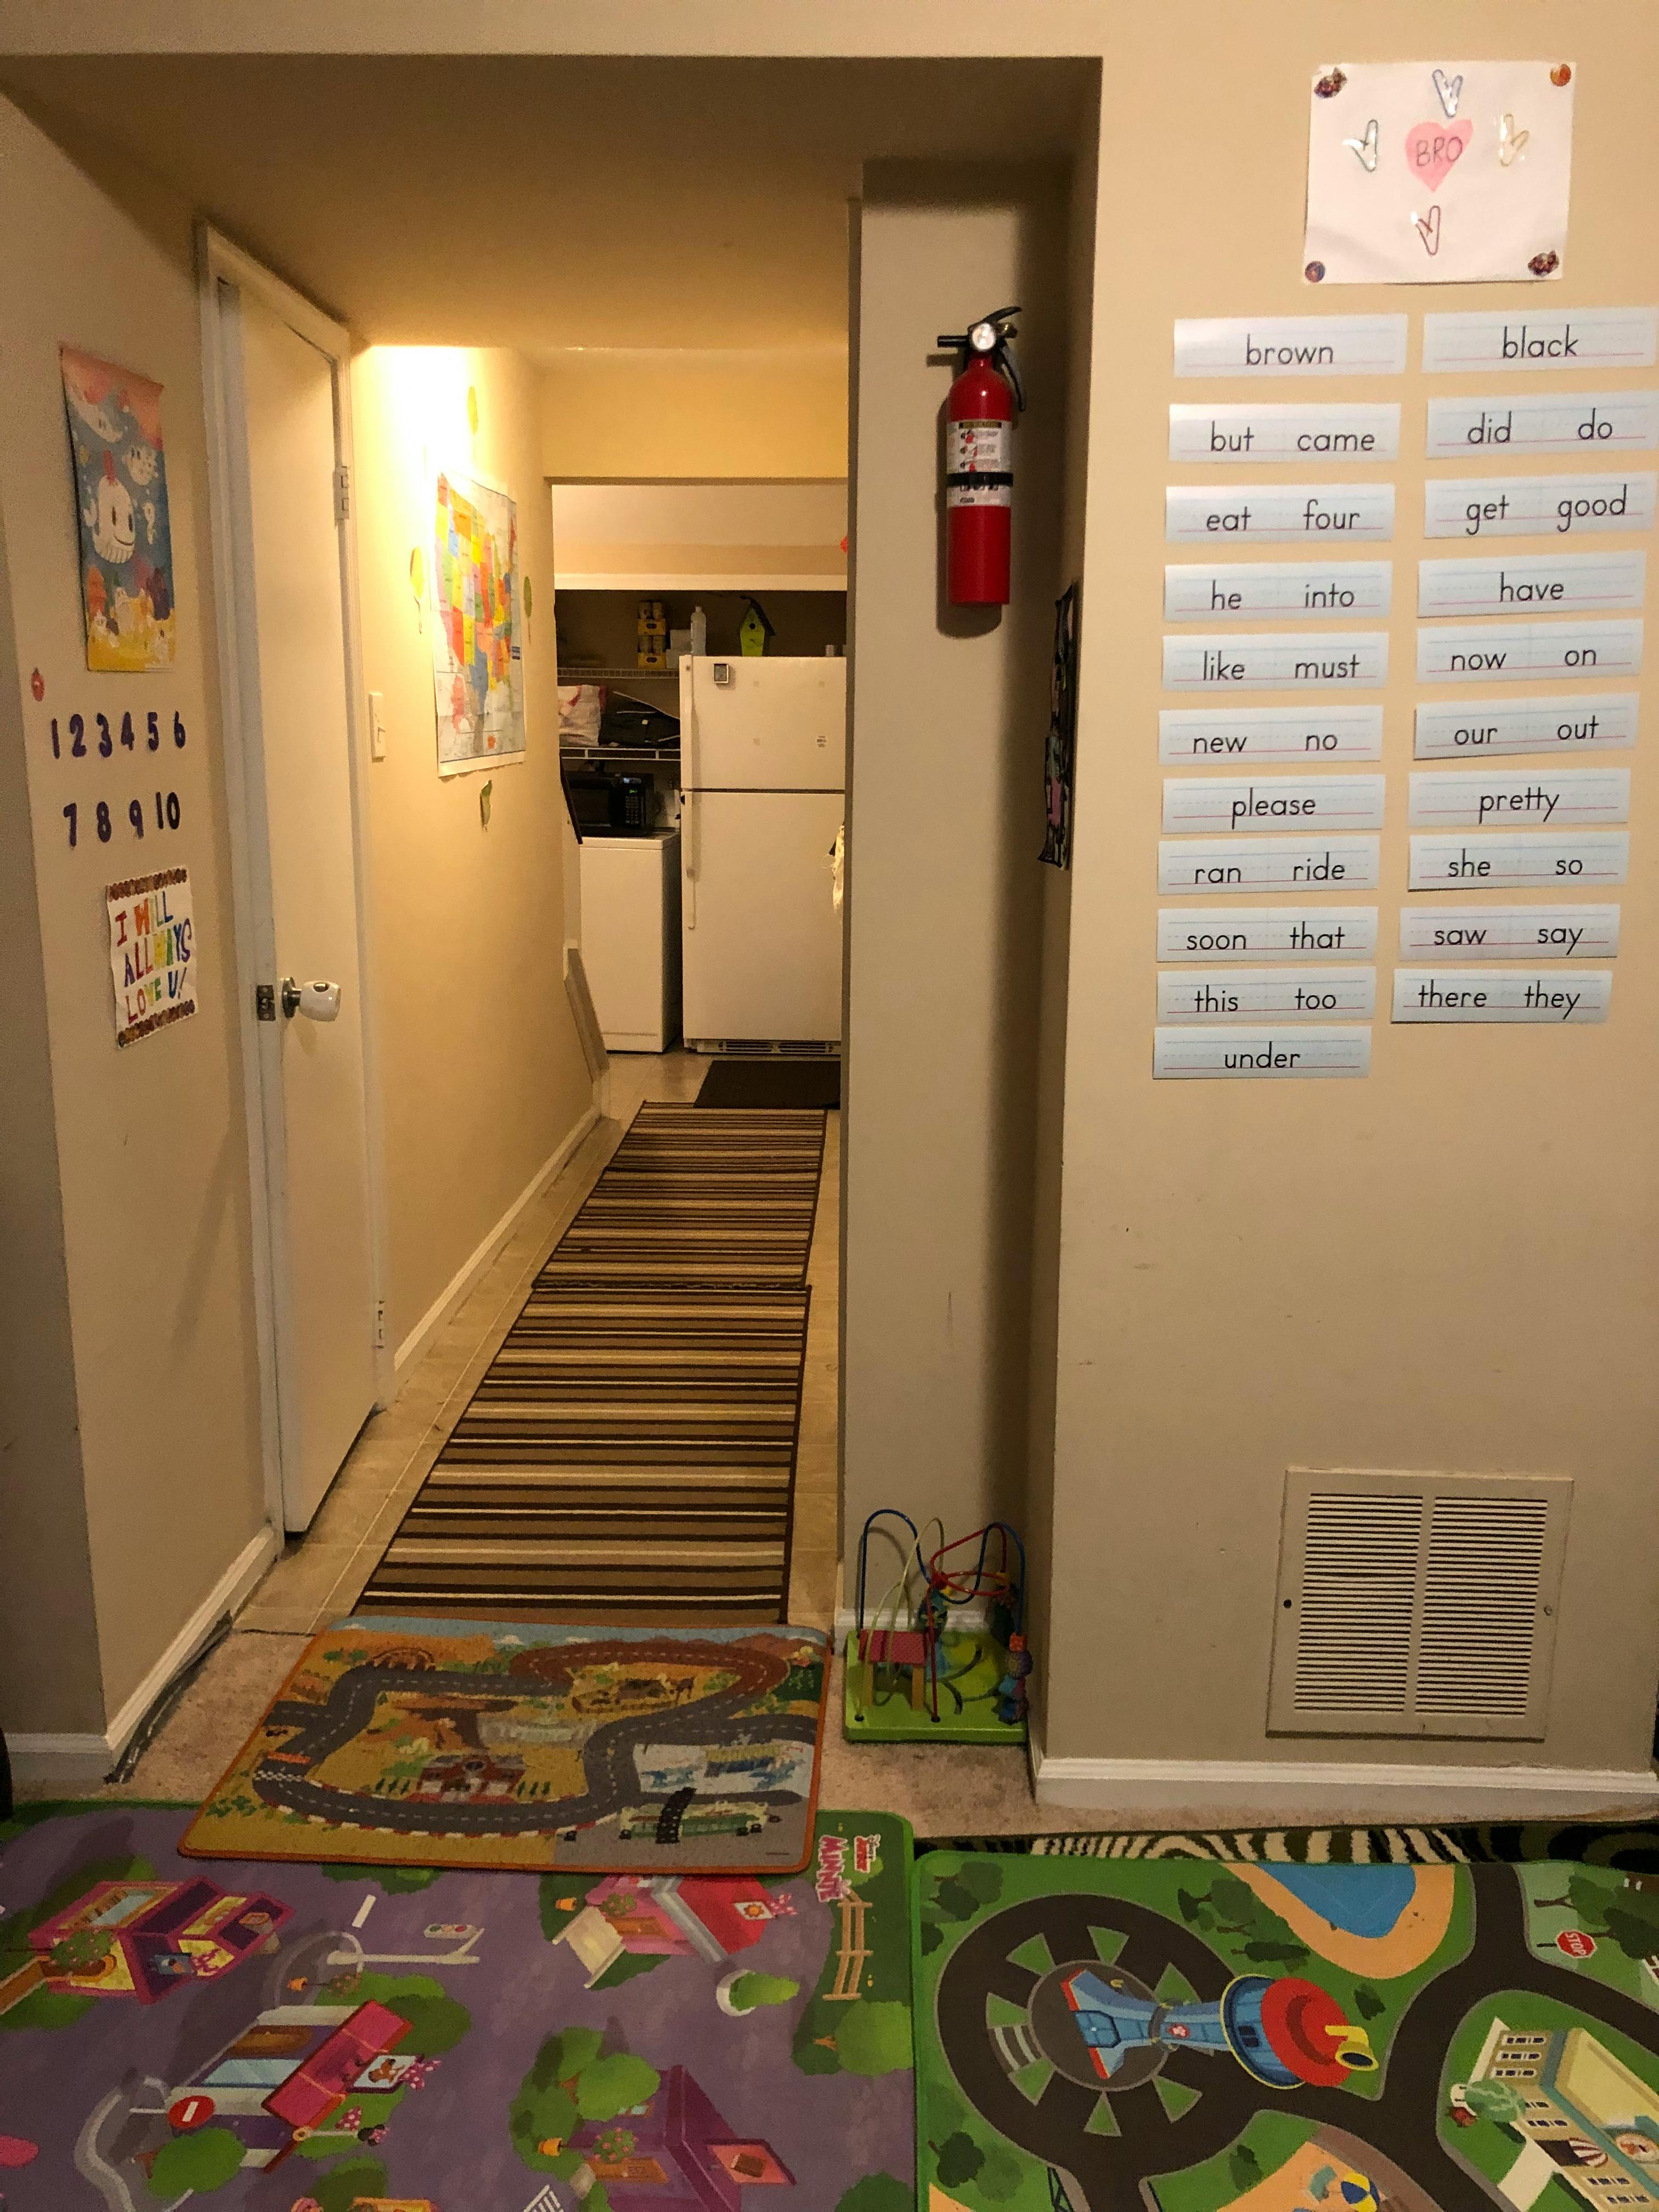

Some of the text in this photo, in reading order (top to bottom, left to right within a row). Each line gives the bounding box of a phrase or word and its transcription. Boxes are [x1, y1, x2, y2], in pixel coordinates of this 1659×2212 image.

[1416, 136, 1463, 167] BRO
[1245, 334, 1334, 366] brown
[1503, 324, 1578, 359] black
[1211, 421, 1375, 452] but came
[1468, 408, 1613, 444] did do
[1206, 499, 1360, 532] eat four
[1466, 484, 1627, 535] get good
[1211, 580, 1355, 611] he into
[1499, 572, 1564, 602] have
[1203, 650, 1360, 681] like must
[1451, 649, 1596, 671] now on
[51, 710, 186, 759] 1 2 3 4 5 6
[1193, 735, 1338, 754] new no
[1454, 715, 1600, 746] our out
[63, 791, 181, 847] 7 8 9 10
[1232, 787, 1316, 830] please
[1479, 786, 1560, 825] pretty
[1194, 851, 1345, 884] ran ride
[1447, 848, 1583, 878] she so
[115, 890, 174, 947] I WILL
[1186, 921, 1345, 951] soon that
[1434, 927, 1584, 956] saw say
[125, 977, 162, 1025] LOVE
[1193, 984, 1338, 1014] this too
[1418, 979, 1582, 1020] there they
[1224, 1041, 1301, 1070] under
[816, 1835, 849, 1903] MINNIE
[1564, 1932, 1587, 1955] STOP
